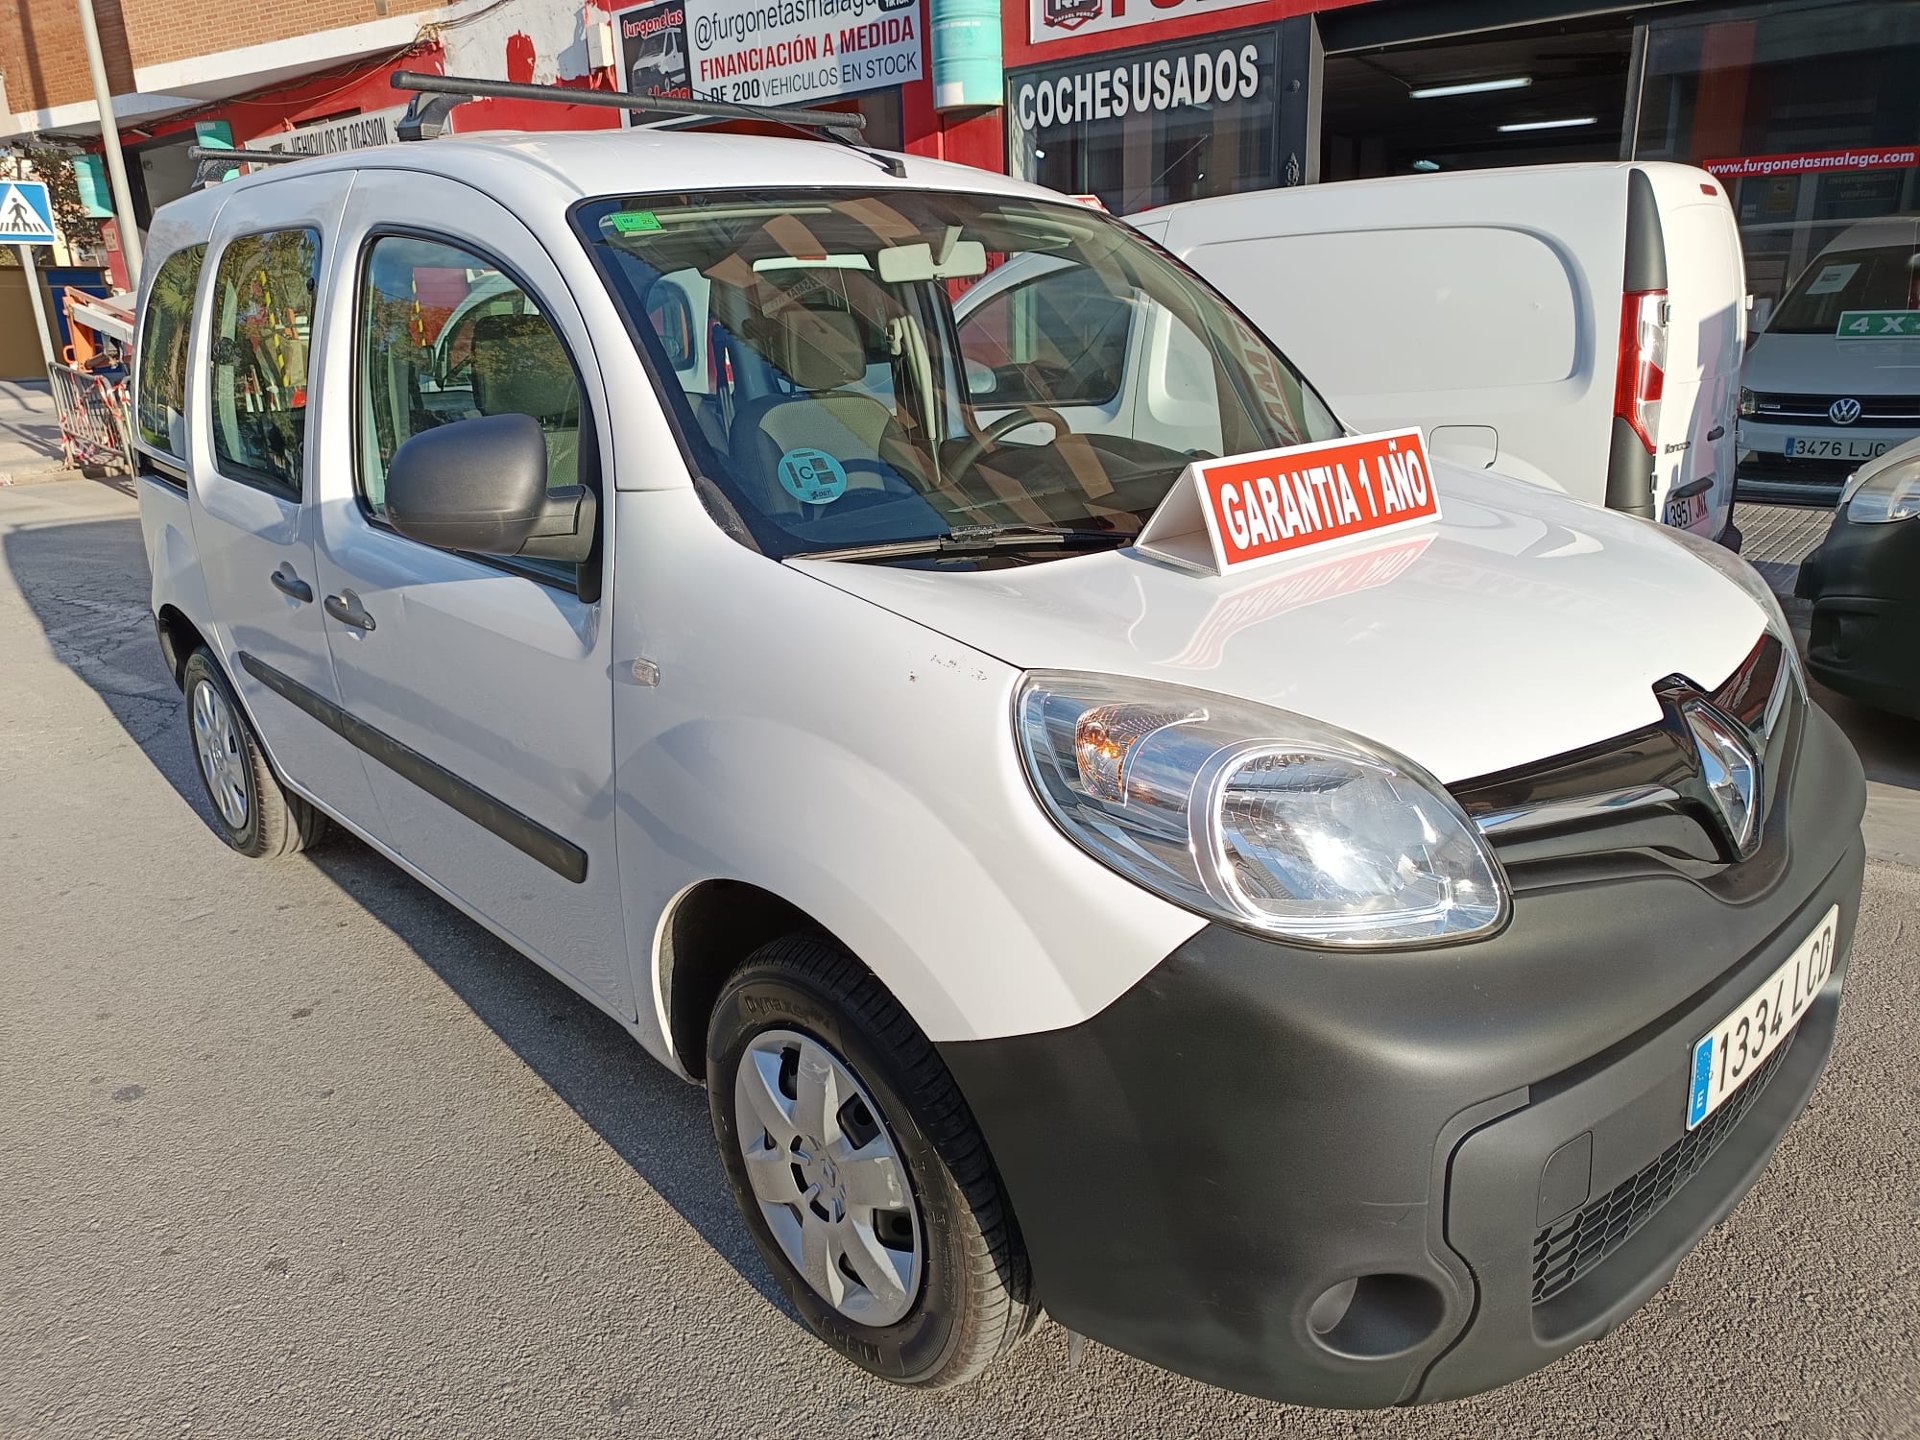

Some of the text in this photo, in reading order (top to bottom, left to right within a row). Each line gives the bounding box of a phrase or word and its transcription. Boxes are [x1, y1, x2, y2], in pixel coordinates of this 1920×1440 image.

[694, 0, 876, 51] @furgonetasmaag
[700, 15, 914, 82] FINANCIACIÓN A MEDIDA
[732, 78, 760, 102] 200
[762, 67, 838, 97] VEHICULOS
[842, 62, 861, 83] EN
[866, 51, 917, 78] STOCK
[350, 117, 388, 150] OCASION
[1708, 152, 1915, 174] www.furgonetasmalaga.com
[1796, 441, 1842, 456] 3476
[1220, 439, 1428, 550] GARANTIA 1 AÑO
[1671, 499, 1692, 527] 3951
[1719, 925, 1831, 1093] 1334 LCD
